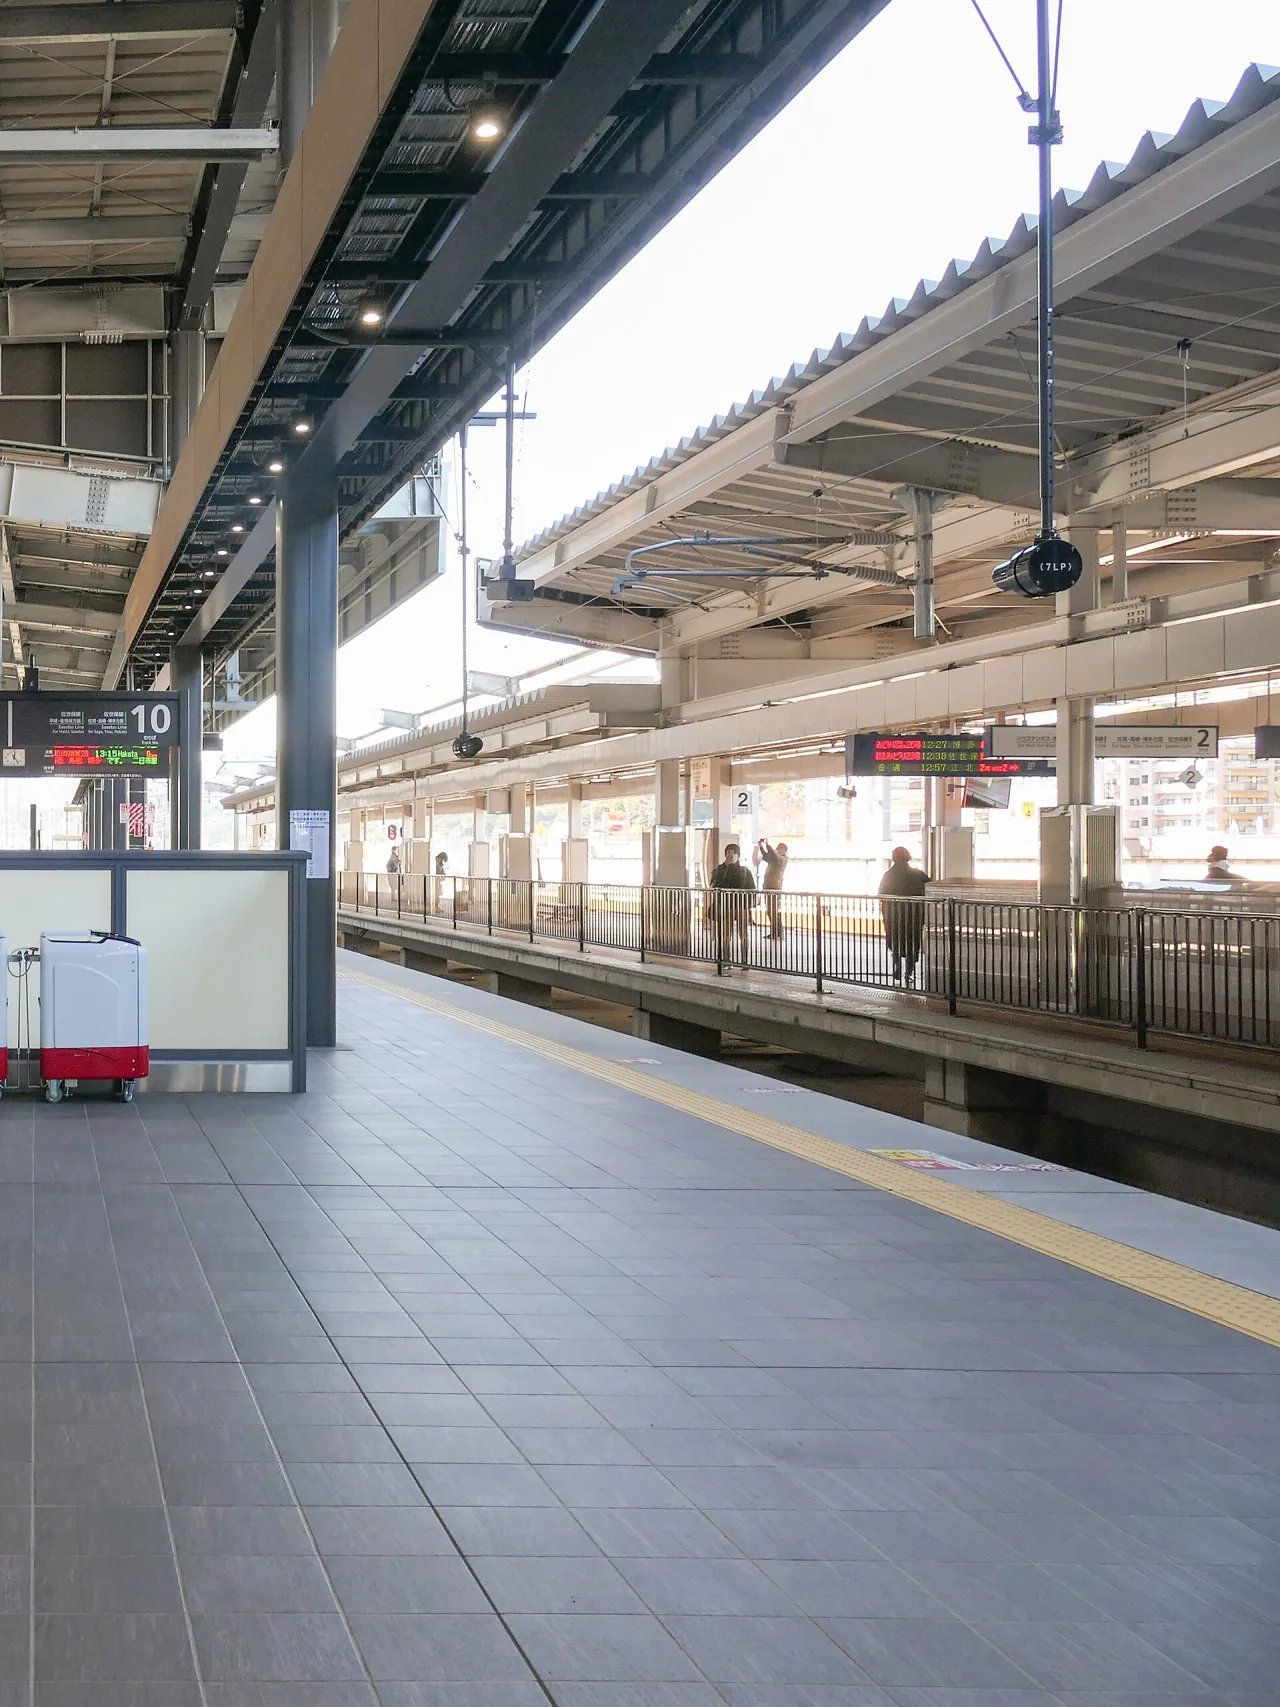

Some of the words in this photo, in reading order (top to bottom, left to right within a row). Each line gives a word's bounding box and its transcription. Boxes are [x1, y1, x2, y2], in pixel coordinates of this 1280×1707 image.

[1040, 562, 1072, 571] (7LP)
[131, 704, 171, 733] 10
[1197, 729, 1210, 747] 2
[922, 740, 948, 748] 12:27
[95, 750, 117, 758] 13:15
[921, 752, 947, 760] 12:38
[921, 763, 947, 772] 12:57
[1186, 771, 1196, 784] 2
[738, 792, 748, 807] 2
